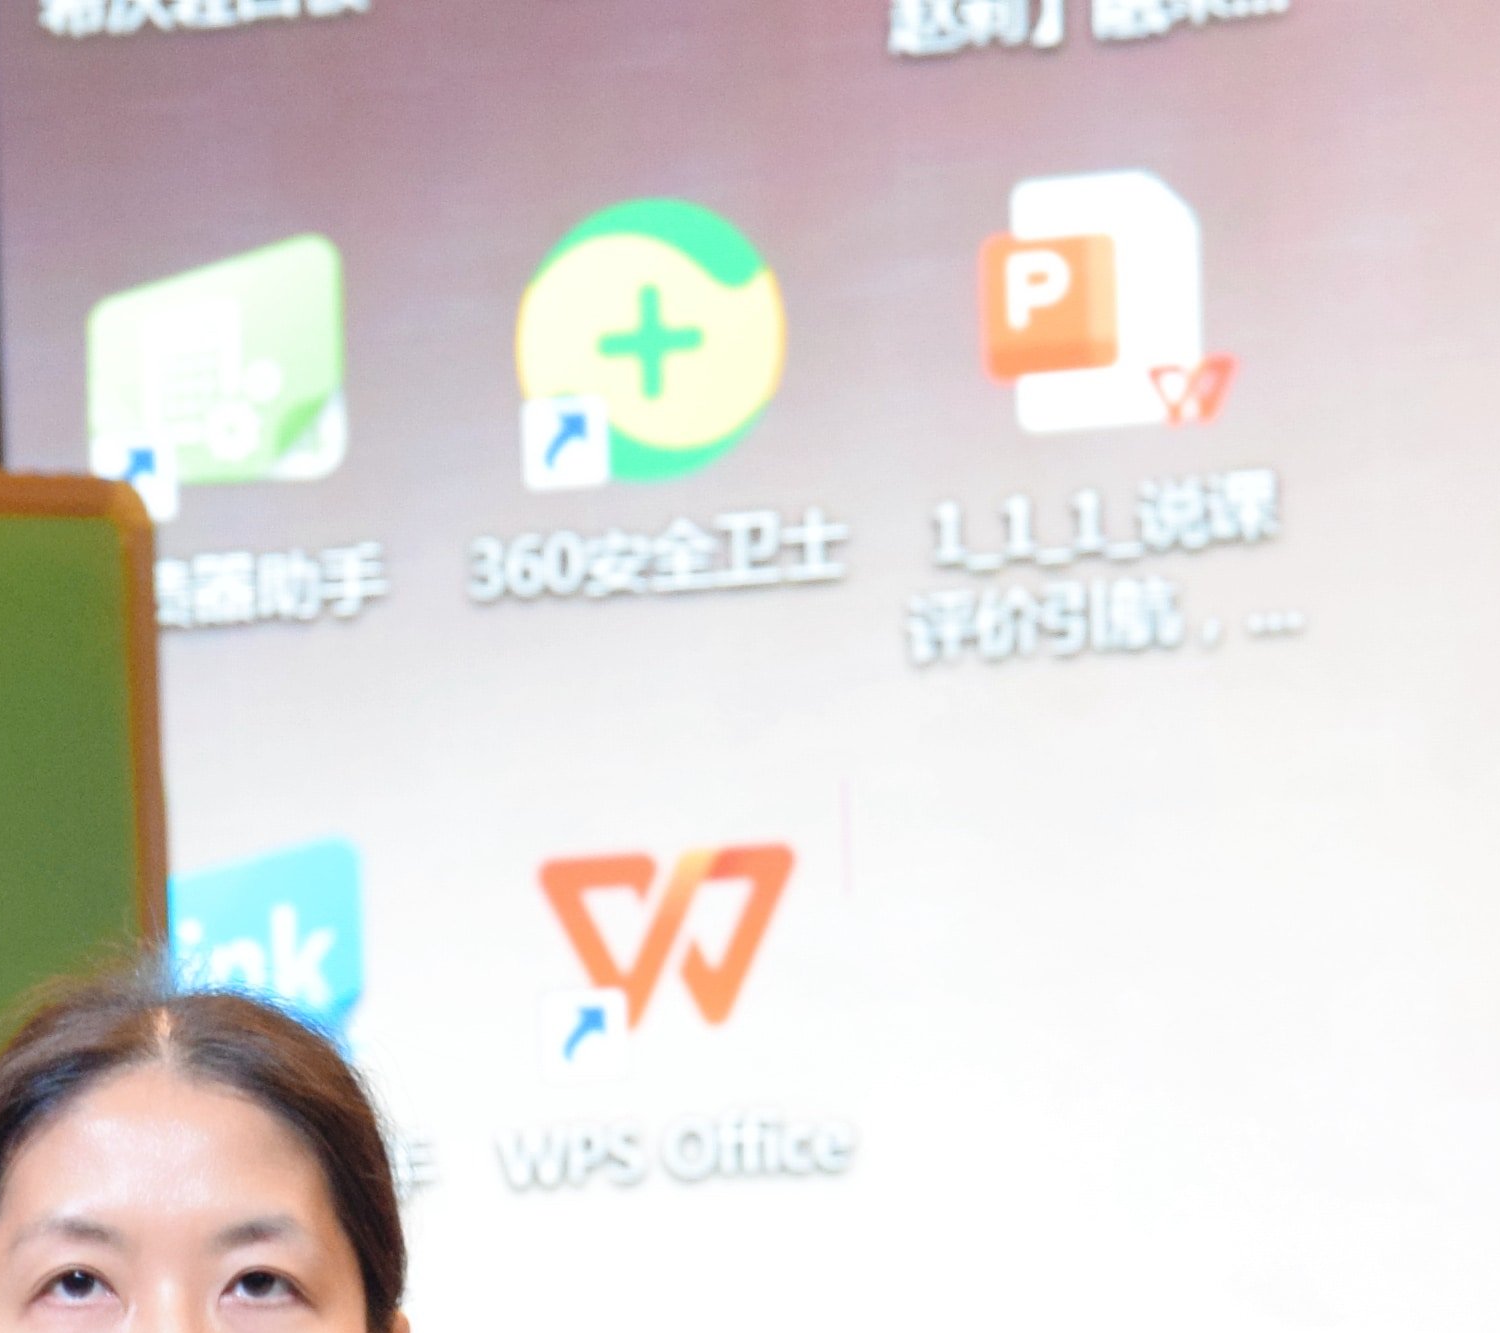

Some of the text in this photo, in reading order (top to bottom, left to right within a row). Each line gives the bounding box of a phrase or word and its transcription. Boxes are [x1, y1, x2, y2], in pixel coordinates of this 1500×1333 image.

[468, 507, 849, 600] 360安全卫士
[499, 1122, 647, 1191] WPS
[661, 1107, 854, 1183] Office
